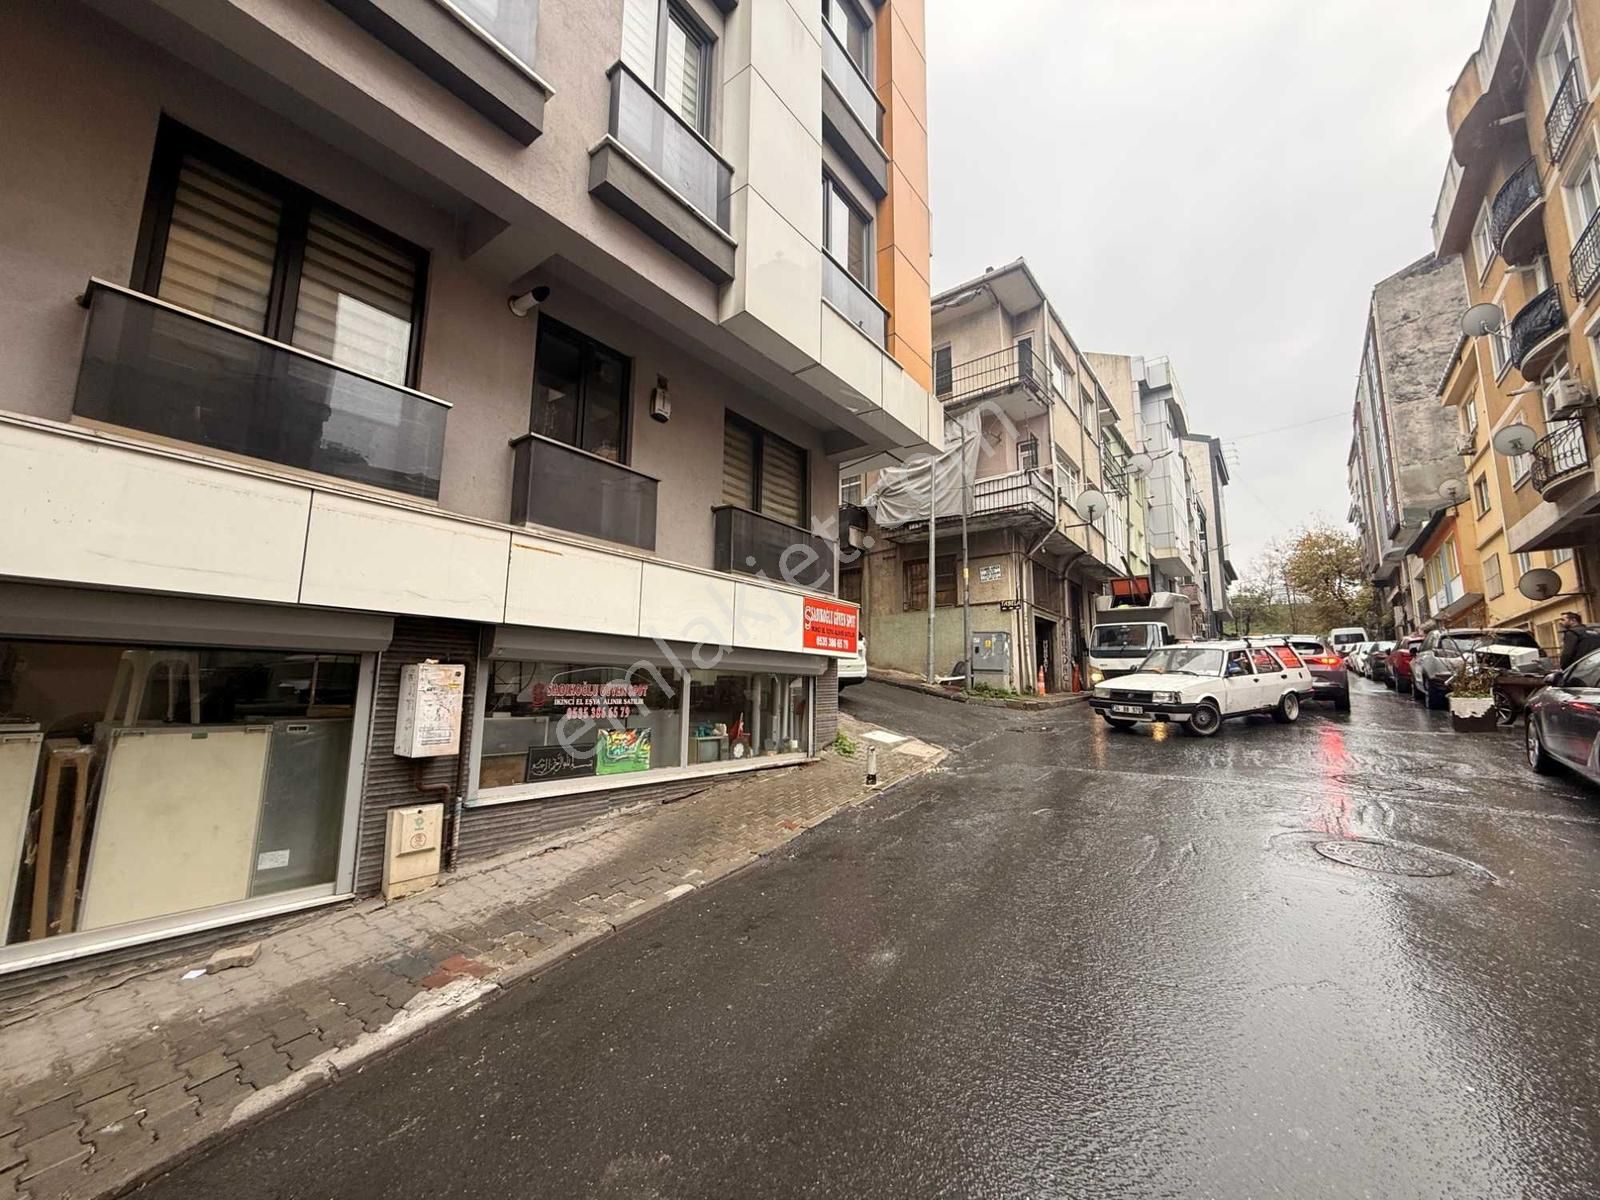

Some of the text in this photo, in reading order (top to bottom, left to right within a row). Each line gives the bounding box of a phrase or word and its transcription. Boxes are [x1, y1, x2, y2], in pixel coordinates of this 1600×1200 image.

[547, 682, 599, 696] SADIKOĞLU
[554, 697, 575, 705] İKİNCİ
[585, 698, 601, 706] EŞYA
[566, 706, 589, 719] 0535
[607, 706, 619, 718] 65
[620, 706, 631, 718] 79
